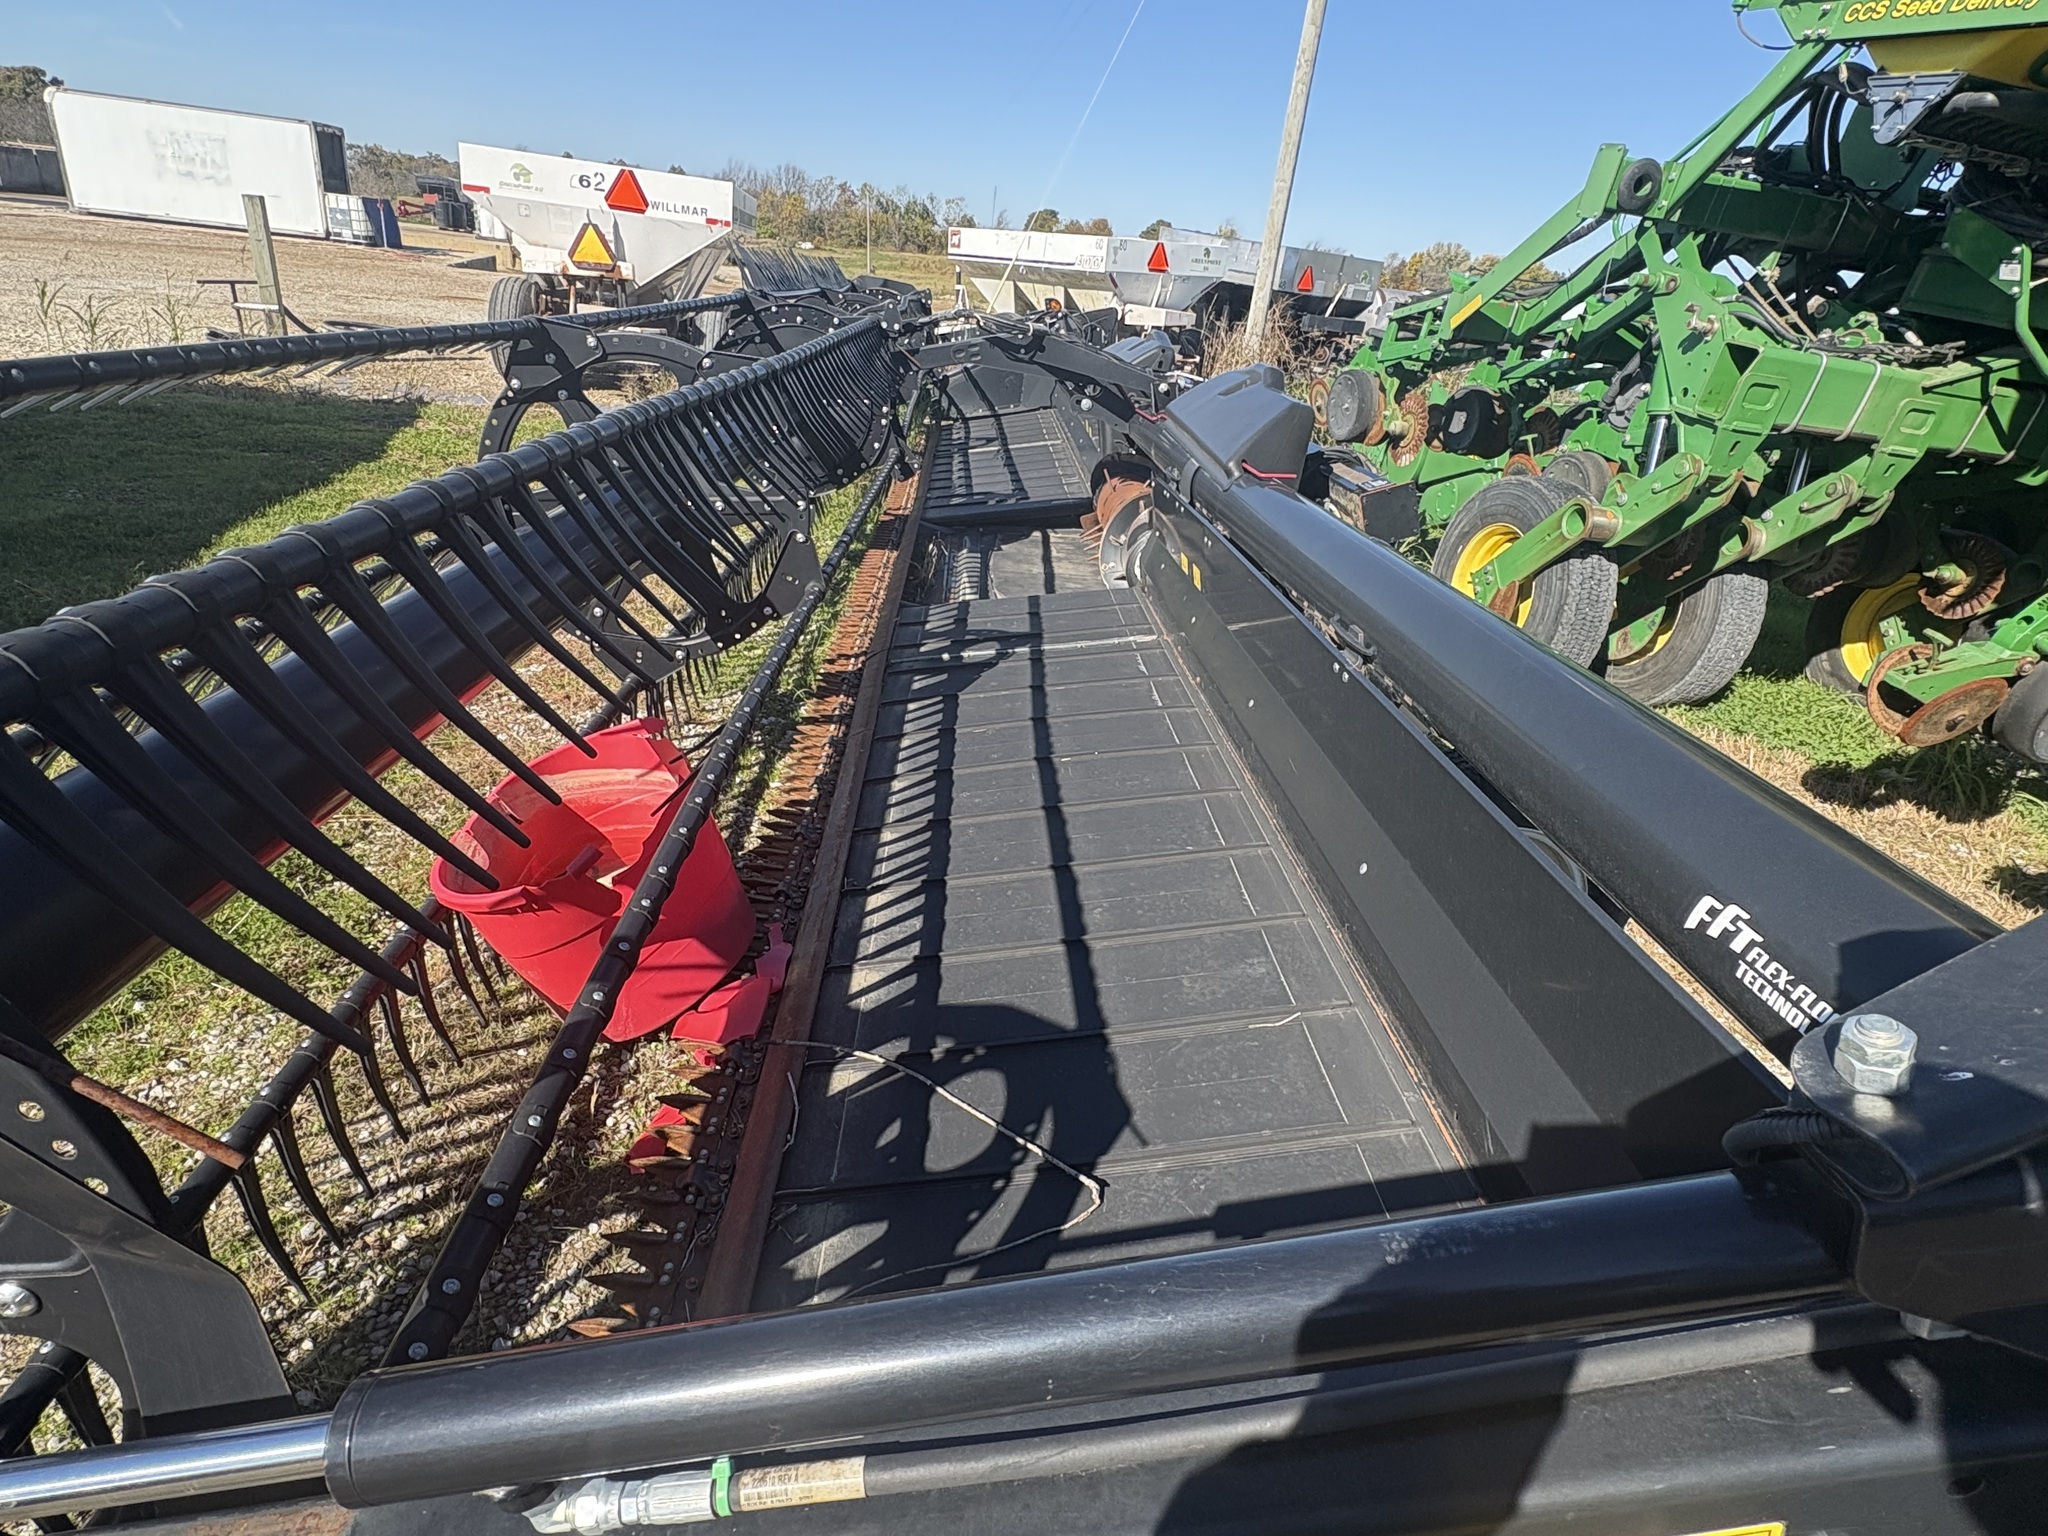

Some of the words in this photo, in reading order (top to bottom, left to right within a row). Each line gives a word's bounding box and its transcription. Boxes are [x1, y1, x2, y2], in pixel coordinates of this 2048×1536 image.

[1844, 0, 1890, 22] CCS
[1891, 0, 1948, 18] Seed
[578, 171, 606, 192] 62
[650, 200, 708, 217] WILLMAR
[1683, 895, 1765, 954] FFT
